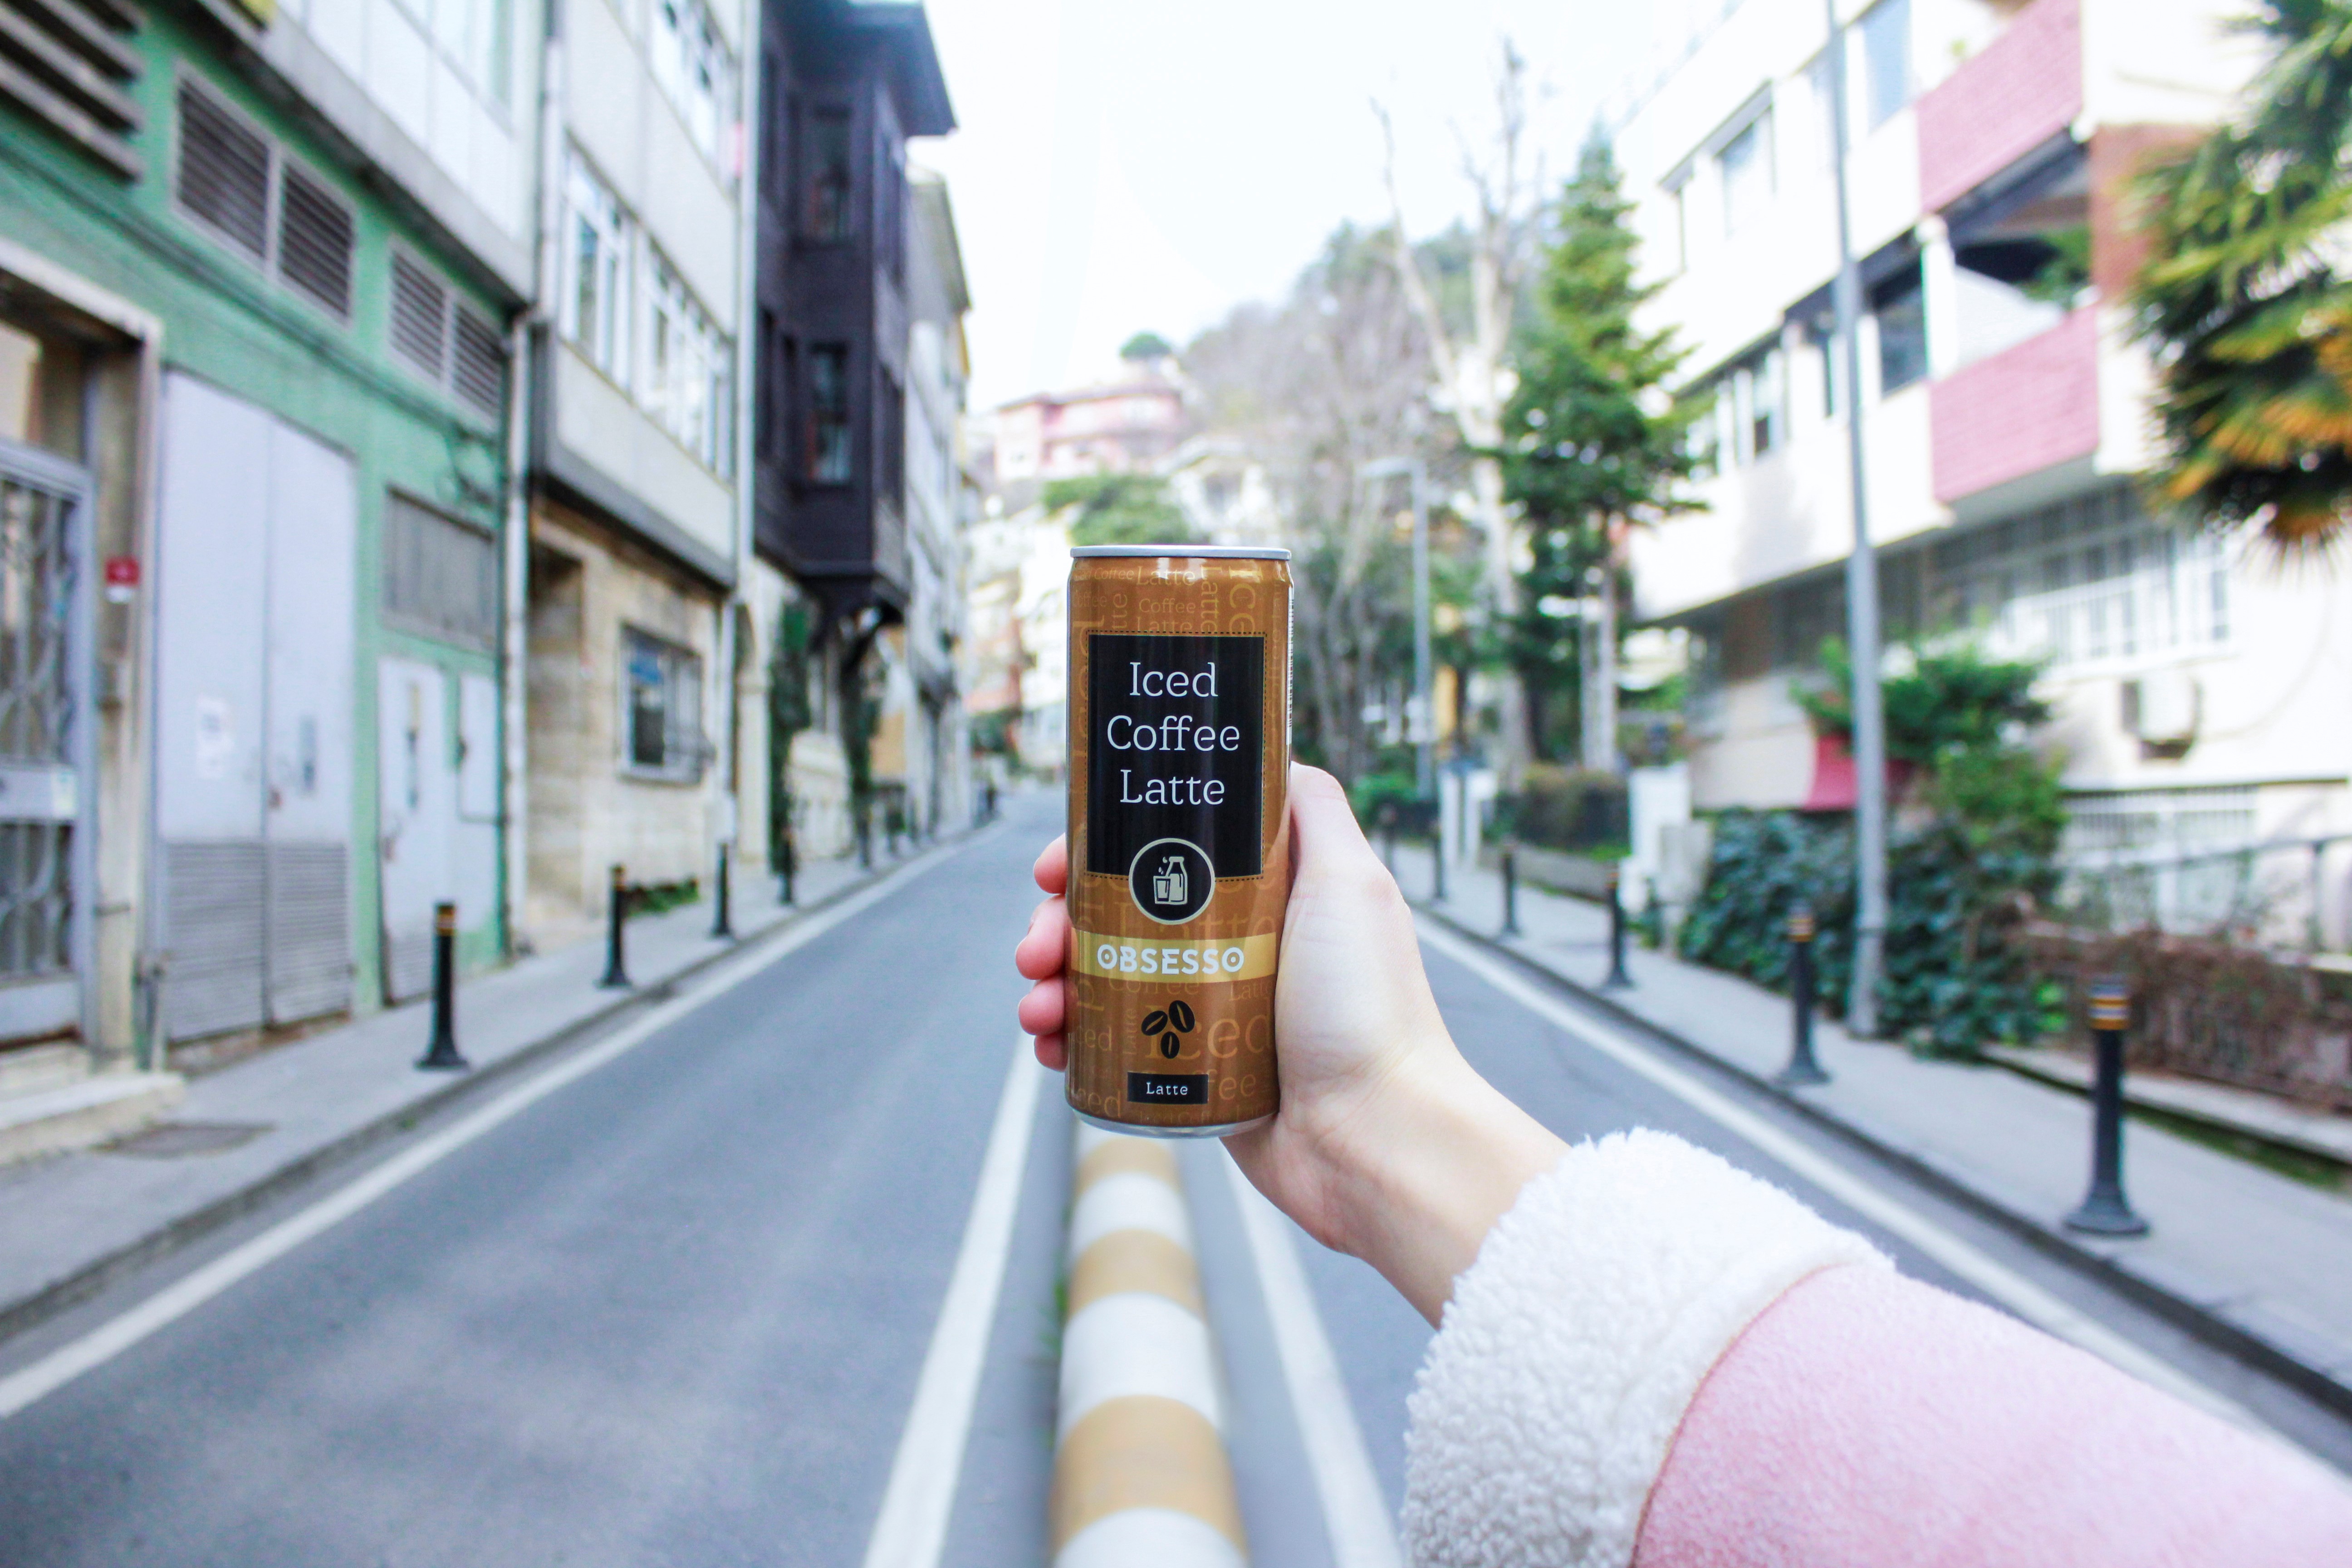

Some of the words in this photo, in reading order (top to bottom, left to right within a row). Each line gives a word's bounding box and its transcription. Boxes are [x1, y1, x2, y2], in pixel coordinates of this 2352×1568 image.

[1137, 566, 1196, 586] Latte
[1139, 598, 1196, 613] Coffee
[1229, 566, 1264, 636] Ice
[1130, 662, 1218, 697] Iced
[1107, 715, 1240, 751] Coffee
[1120, 769, 1225, 805] Latte
[1097, 944, 1245, 975] OBSESSO
[1146, 1082, 1188, 1095] Latte
